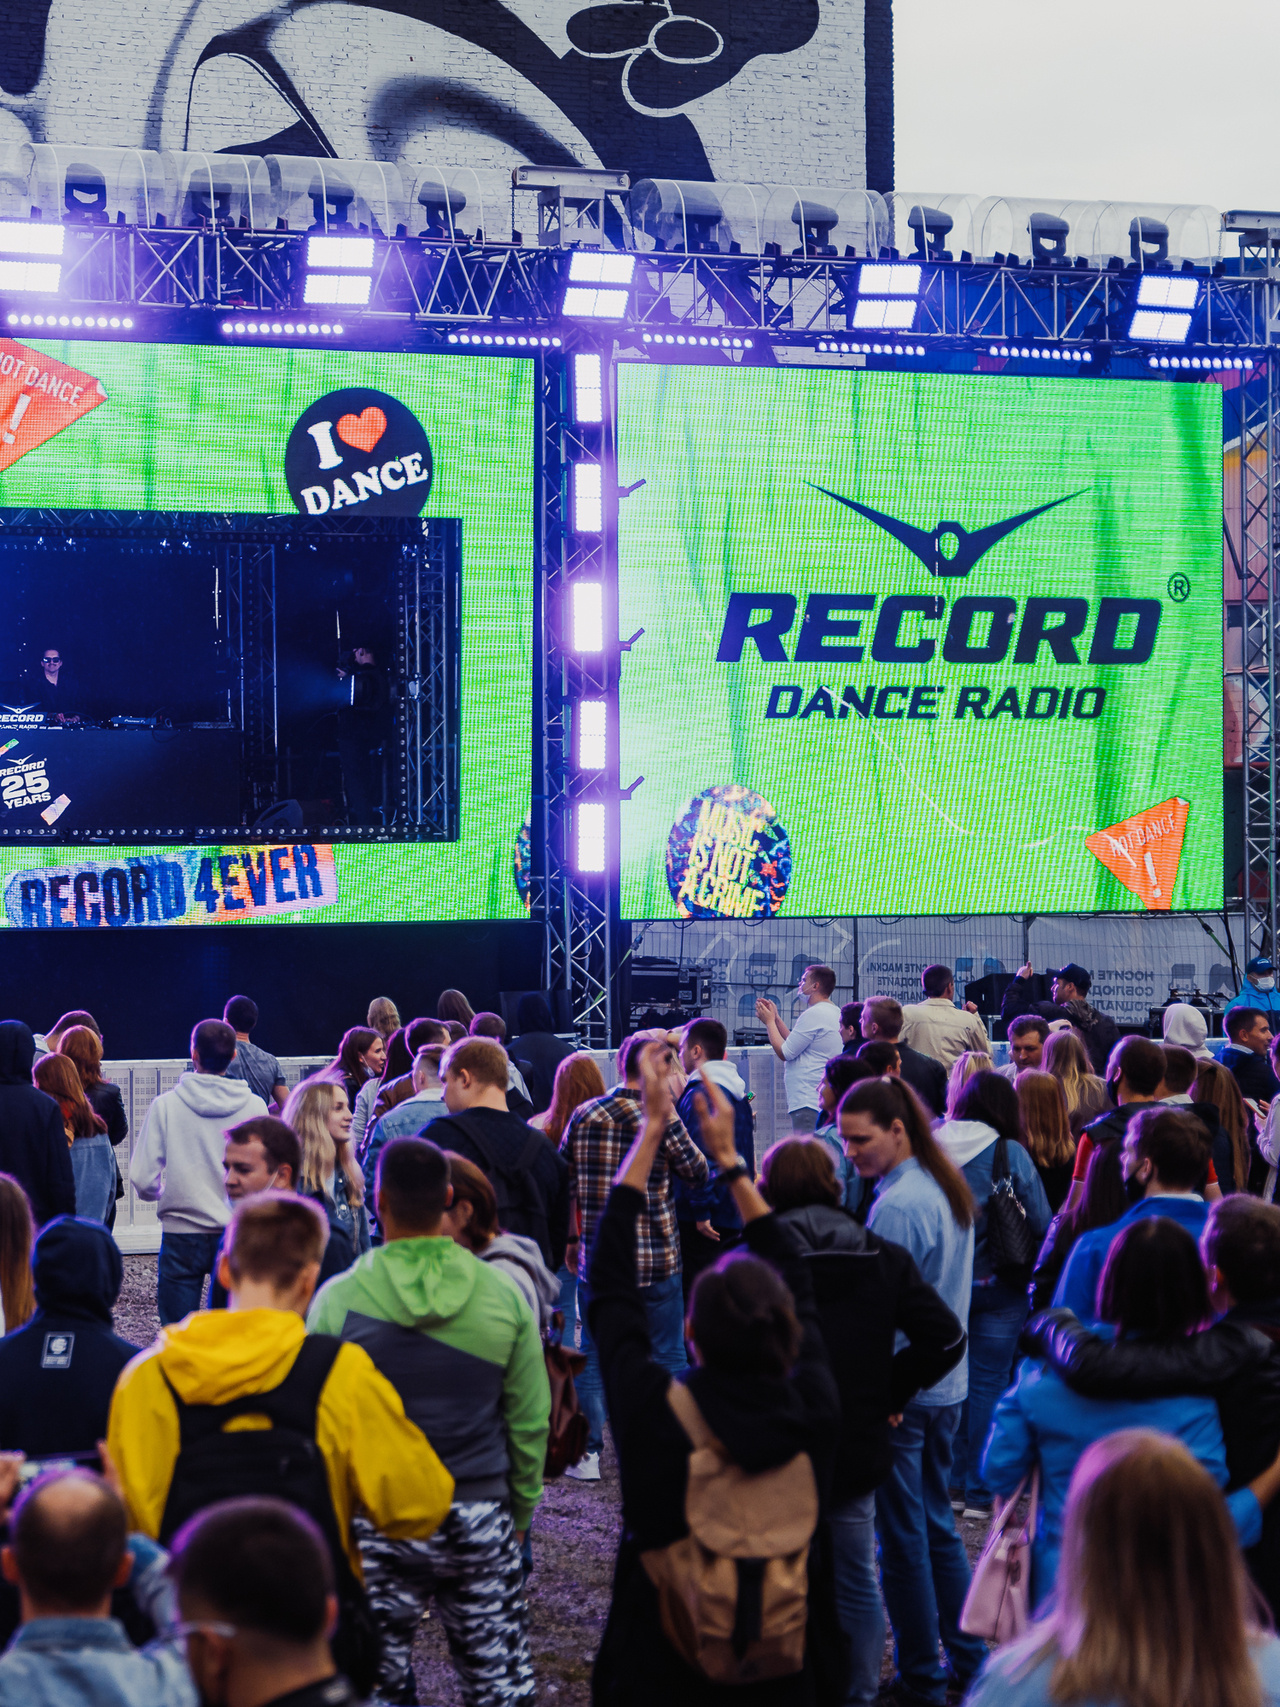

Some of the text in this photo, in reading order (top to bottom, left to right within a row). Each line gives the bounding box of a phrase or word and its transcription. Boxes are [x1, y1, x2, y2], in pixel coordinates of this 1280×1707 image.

[24, 366, 84, 407] DANCE
[306, 420, 343, 470] I
[300, 452, 429, 515] DANCE
[715, 592, 1164, 665] RECORD
[765, 685, 1107, 720] DANCE RADIO
[0, 769, 50, 800] 25
[3, 792, 52, 809] YEARS
[698, 800, 764, 852] MUSIC
[1136, 813, 1177, 846] DANCE
[688, 832, 714, 869] IS
[710, 838, 756, 884] NOT
[20, 844, 324, 928] RECORD 4EVER
[678, 866, 765, 917] A CRIME
